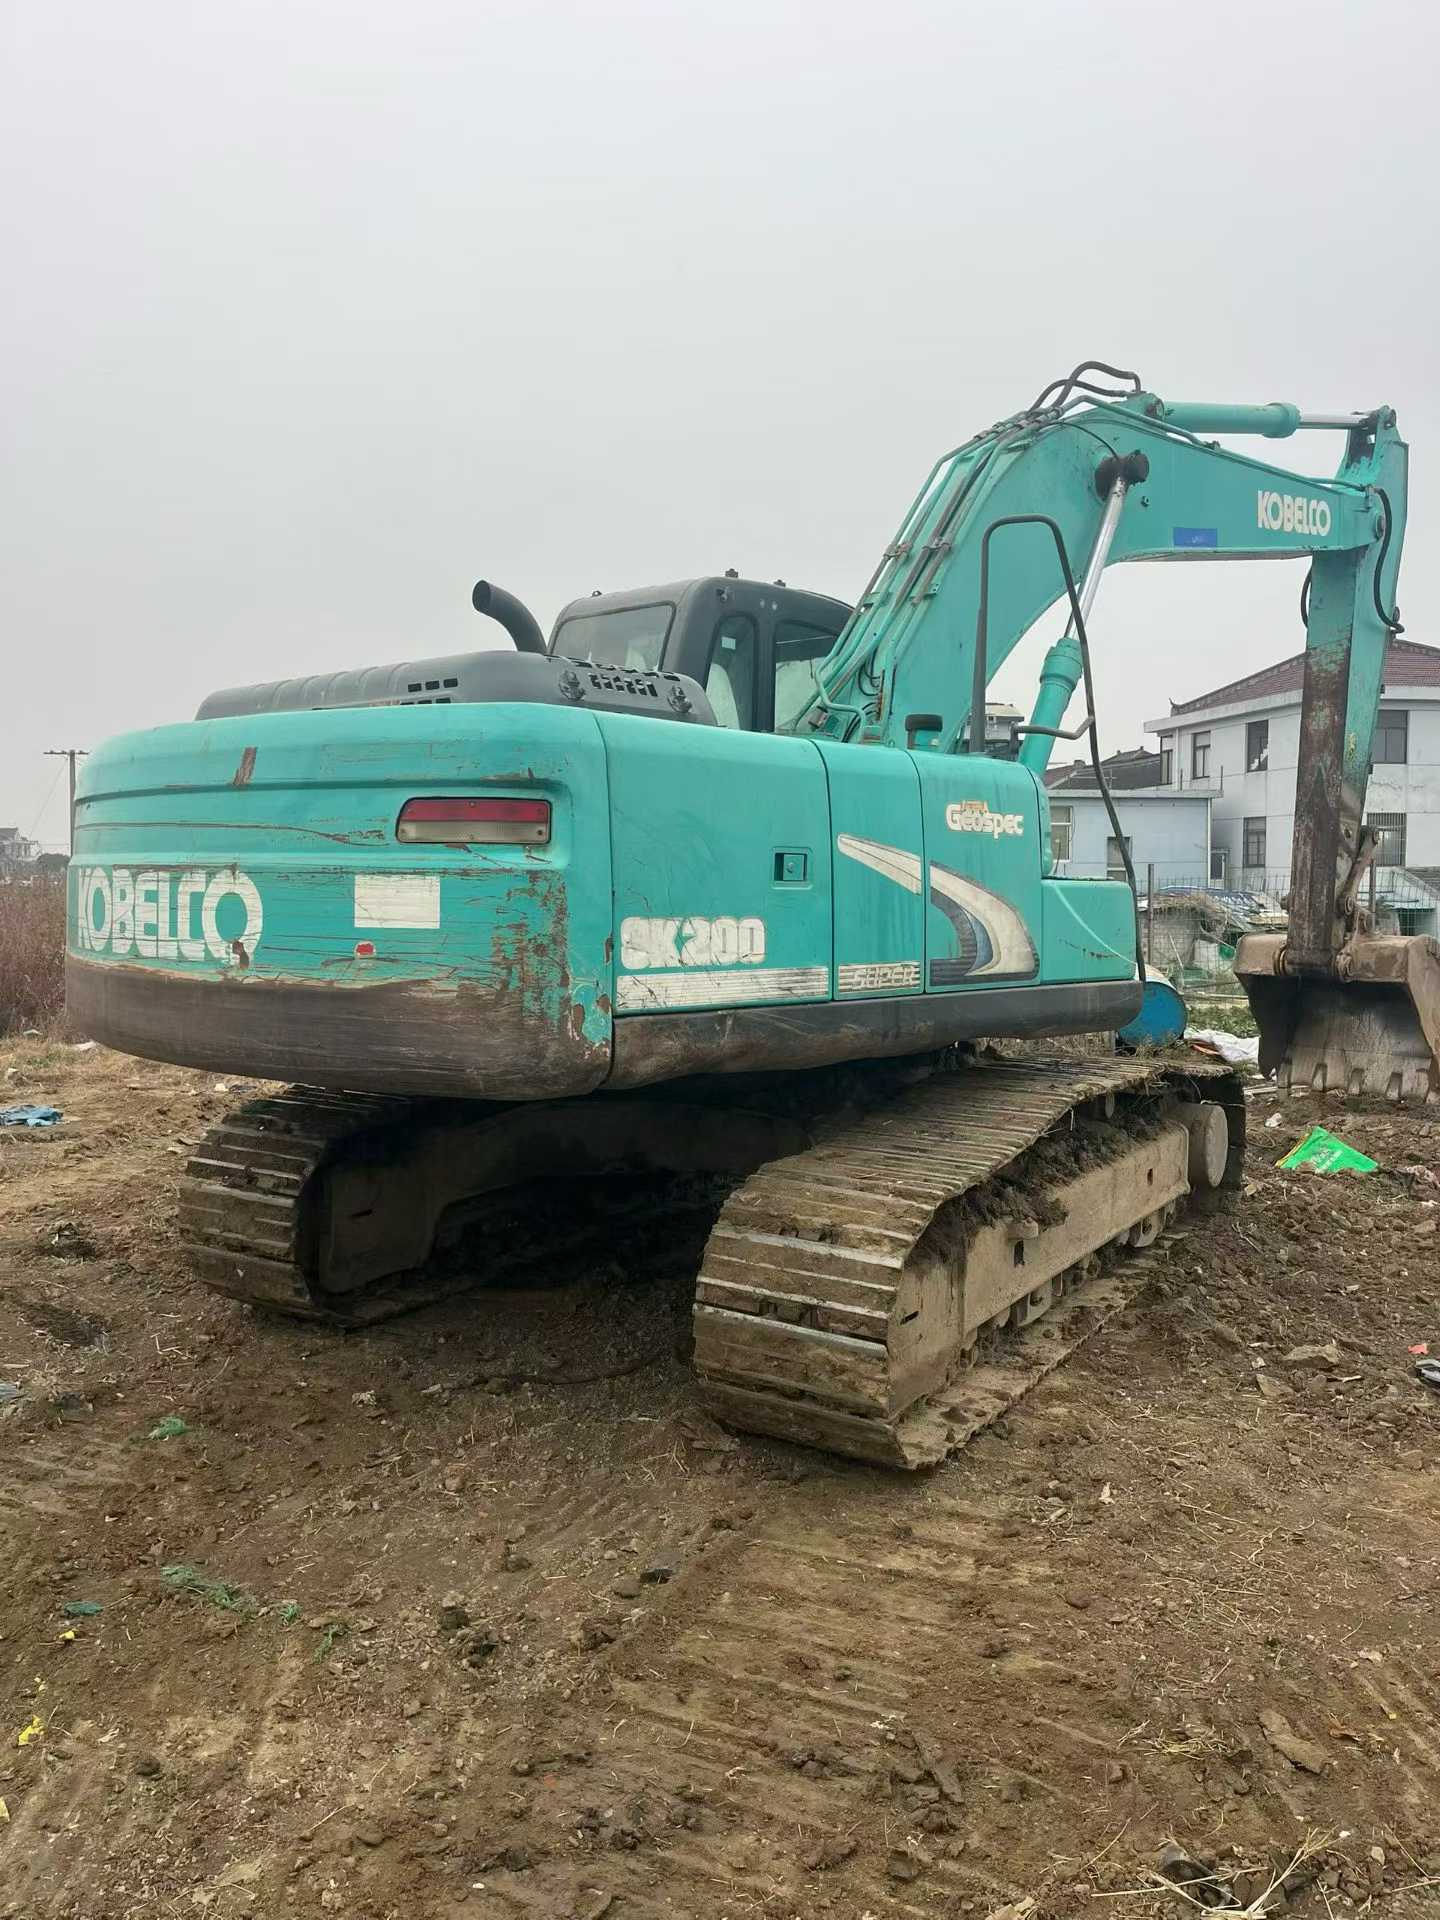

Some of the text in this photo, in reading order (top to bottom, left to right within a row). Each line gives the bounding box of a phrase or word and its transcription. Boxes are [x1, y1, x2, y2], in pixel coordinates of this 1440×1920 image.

[1258, 490, 1331, 537] KOBELCO
[78, 867, 263, 965] KOBELCO
[621, 917, 766, 970] SK200
